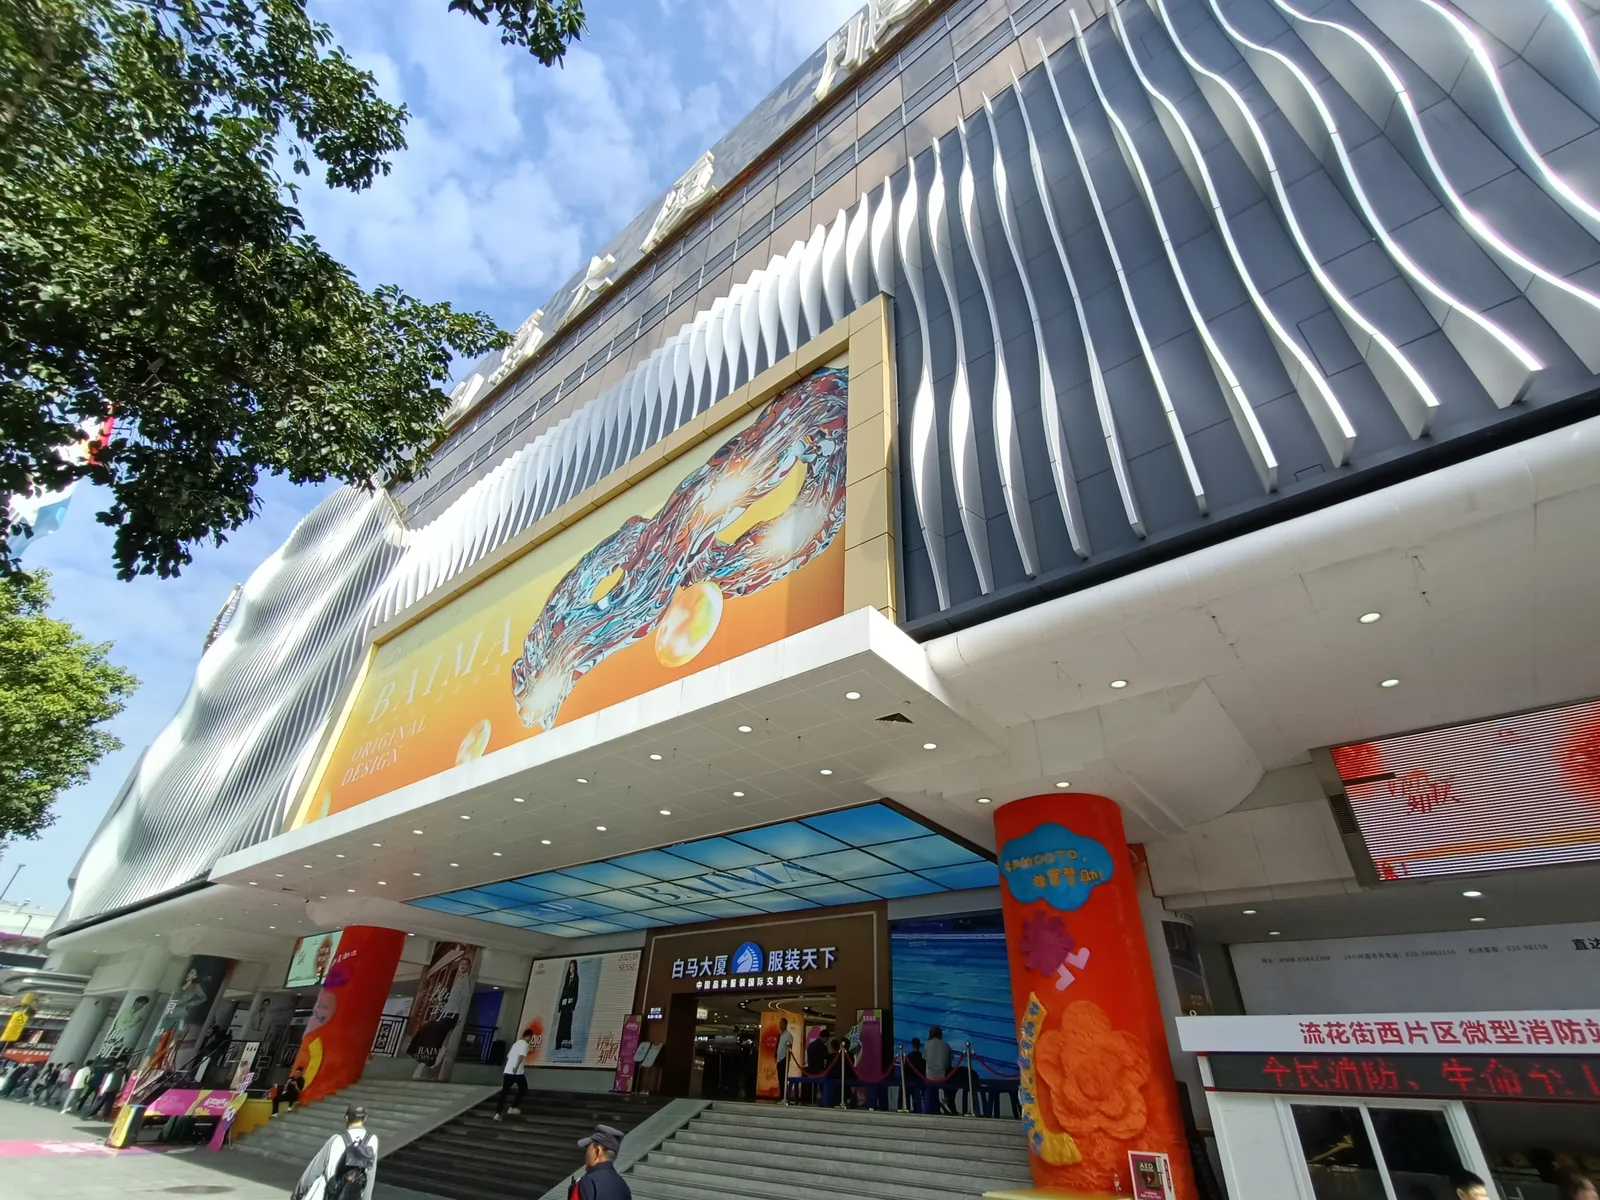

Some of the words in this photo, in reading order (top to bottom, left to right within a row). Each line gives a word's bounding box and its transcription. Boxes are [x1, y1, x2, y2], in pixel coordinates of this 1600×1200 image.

[367, 615, 512, 725] BAIMA
[351, 715, 428, 763] ORIGINAL
[340, 745, 404, 787] DESIGN
[671, 954, 729, 979] 白马大厦
[767, 946, 836, 972] 服装天下
[696, 975, 803, 990] 中国品牌服装国际交易中心
[1139, 1162, 1154, 1170] AED
